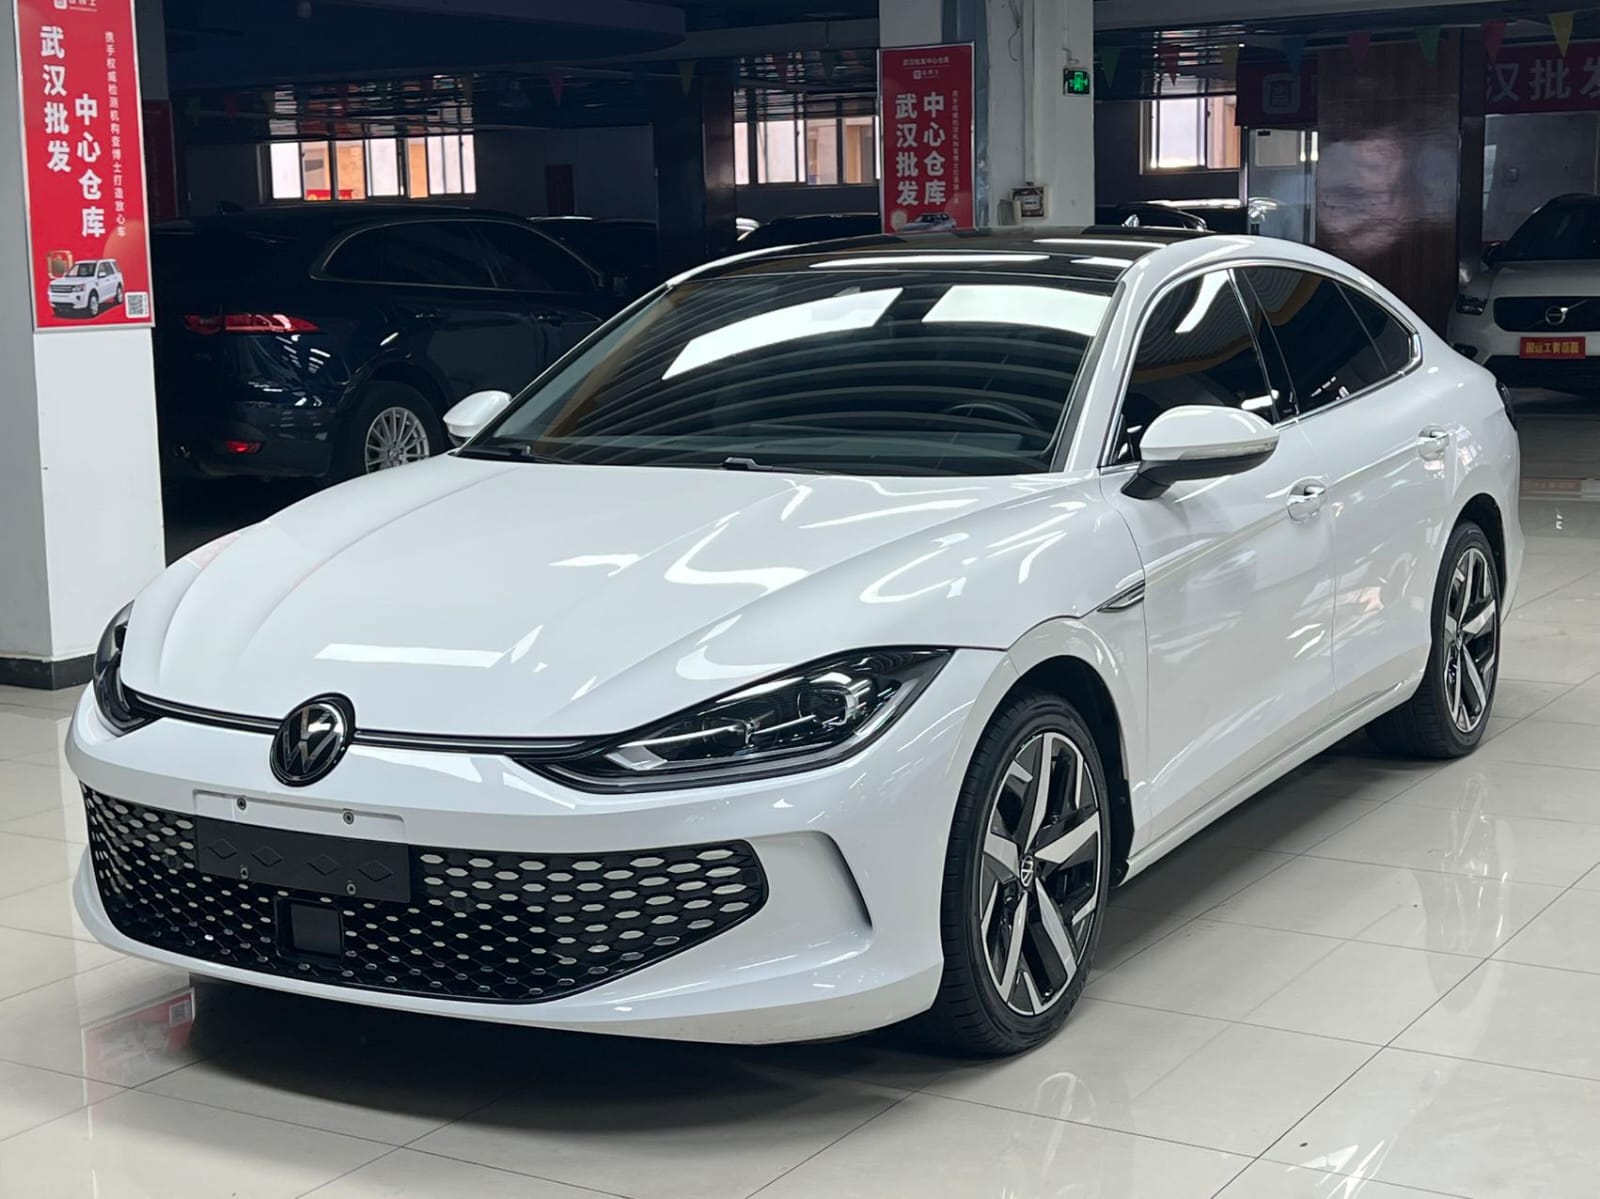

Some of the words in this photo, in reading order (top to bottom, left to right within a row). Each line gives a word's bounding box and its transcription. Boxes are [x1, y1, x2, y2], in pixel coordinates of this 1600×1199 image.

[40, 26, 72, 174] 武汉批发
[895, 93, 919, 207] 武汉批发
[923, 92, 946, 206] 中心仓库
[74, 93, 106, 238] 中心仓库
